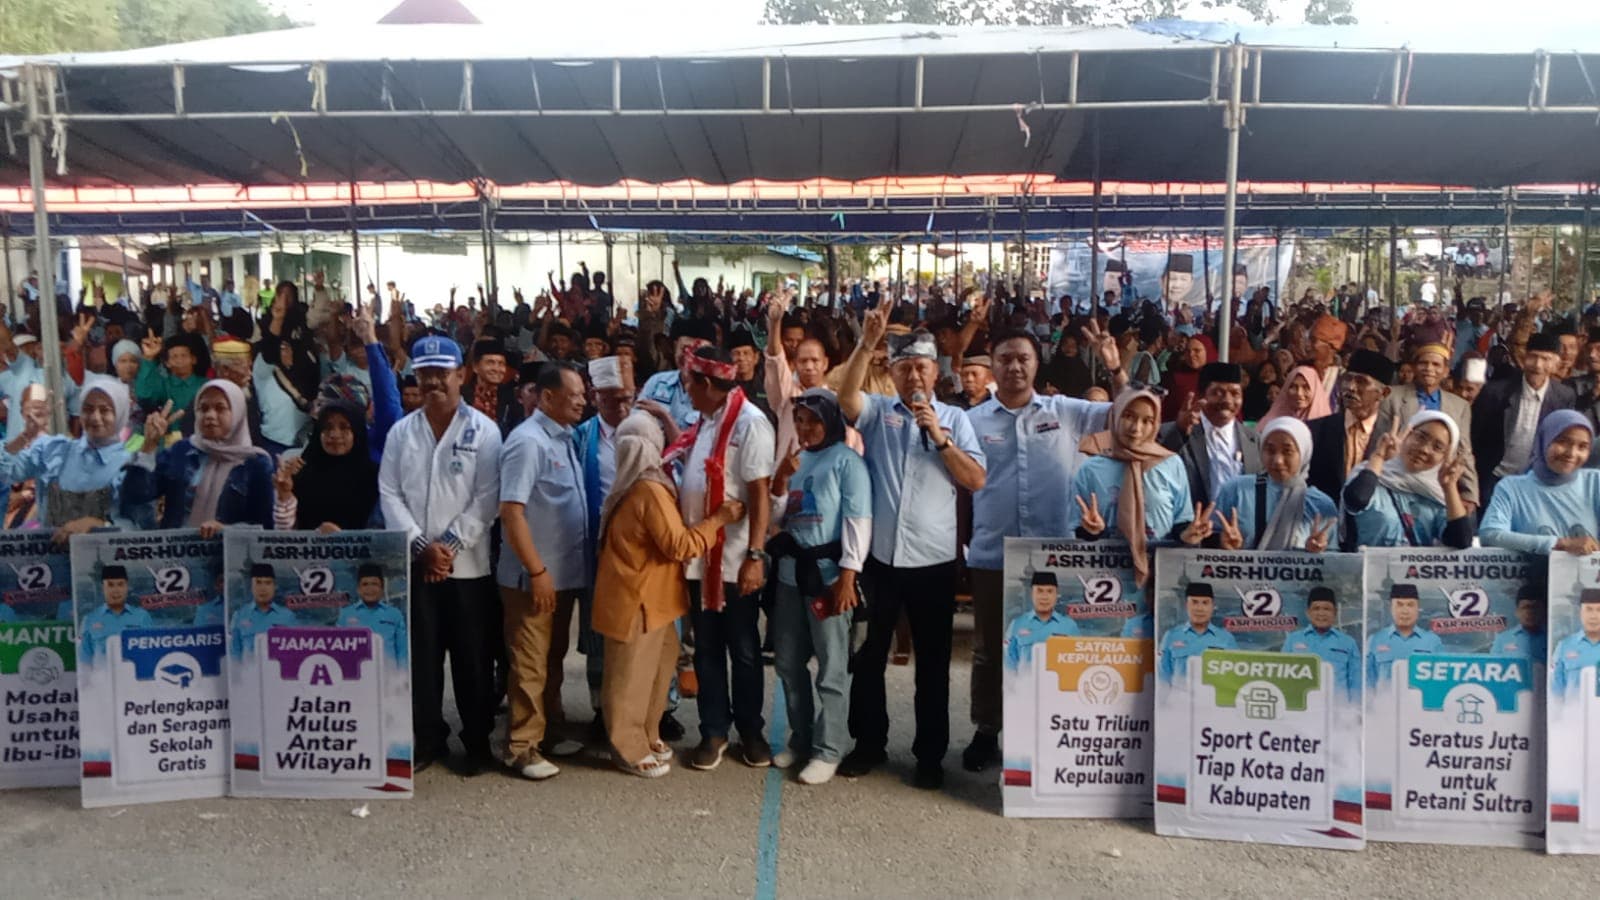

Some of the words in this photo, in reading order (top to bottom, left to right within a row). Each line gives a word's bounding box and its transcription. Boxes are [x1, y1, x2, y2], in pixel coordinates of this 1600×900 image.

[262, 546, 371, 559] ASR-HUGUA
[1042, 543, 1096, 553] PROGRAM
[1197, 554, 1254, 564] PROGRAM
[1258, 555, 1325, 565] UNGGULAN
[1401, 554, 1459, 563] PROGRAM
[28, 567, 46, 588] 2
[165, 570, 184, 592] 2
[1201, 565, 1323, 581] ASR-HUGUA
[310, 572, 326, 593] 2
[1094, 580, 1113, 603] 2
[1253, 593, 1273, 616] 2
[1460, 592, 1480, 617] 2
[128, 633, 222, 650] PENGGARIS
[1075, 641, 1126, 653] SATRIA
[1057, 653, 1143, 665] KEPULAUAN
[1207, 660, 1313, 680] SPORTIKA
[1415, 661, 1522, 682] SETARA
[6, 688, 78, 706] Modal
[289, 696, 351, 713] Jalan
[8, 708, 79, 724] Usaha
[286, 715, 357, 733] Mulus
[1050, 714, 1090, 731] Satu
[1095, 714, 1150, 732] Triliun
[11, 726, 79, 743] untuk
[127, 720, 157, 736] dan
[163, 717, 230, 734] Seragam
[149, 736, 213, 754] Sekolah
[288, 734, 357, 751] Antar
[1057, 732, 1142, 753] Anggaran
[1200, 727, 1253, 752] Sport
[1259, 731, 1321, 754] Center
[1409, 728, 1484, 749] Seratus
[1488, 731, 1530, 751] Juta
[4, 744, 80, 762] Ibu-ib
[1075, 751, 1125, 767] untuk
[1426, 750, 1512, 771] Asuransi
[158, 756, 207, 772] Gratis
[276, 752, 371, 774] Wilayah
[1196, 754, 1235, 781] Tiap
[1241, 758, 1284, 780] Kota
[1290, 761, 1325, 783] dan
[1054, 767, 1145, 788] Kepulauan
[1441, 772, 1498, 790] untuk
[1209, 783, 1311, 812] Kabupaten
[1405, 790, 1468, 811] Petani
[1472, 792, 1533, 814] Sultra
